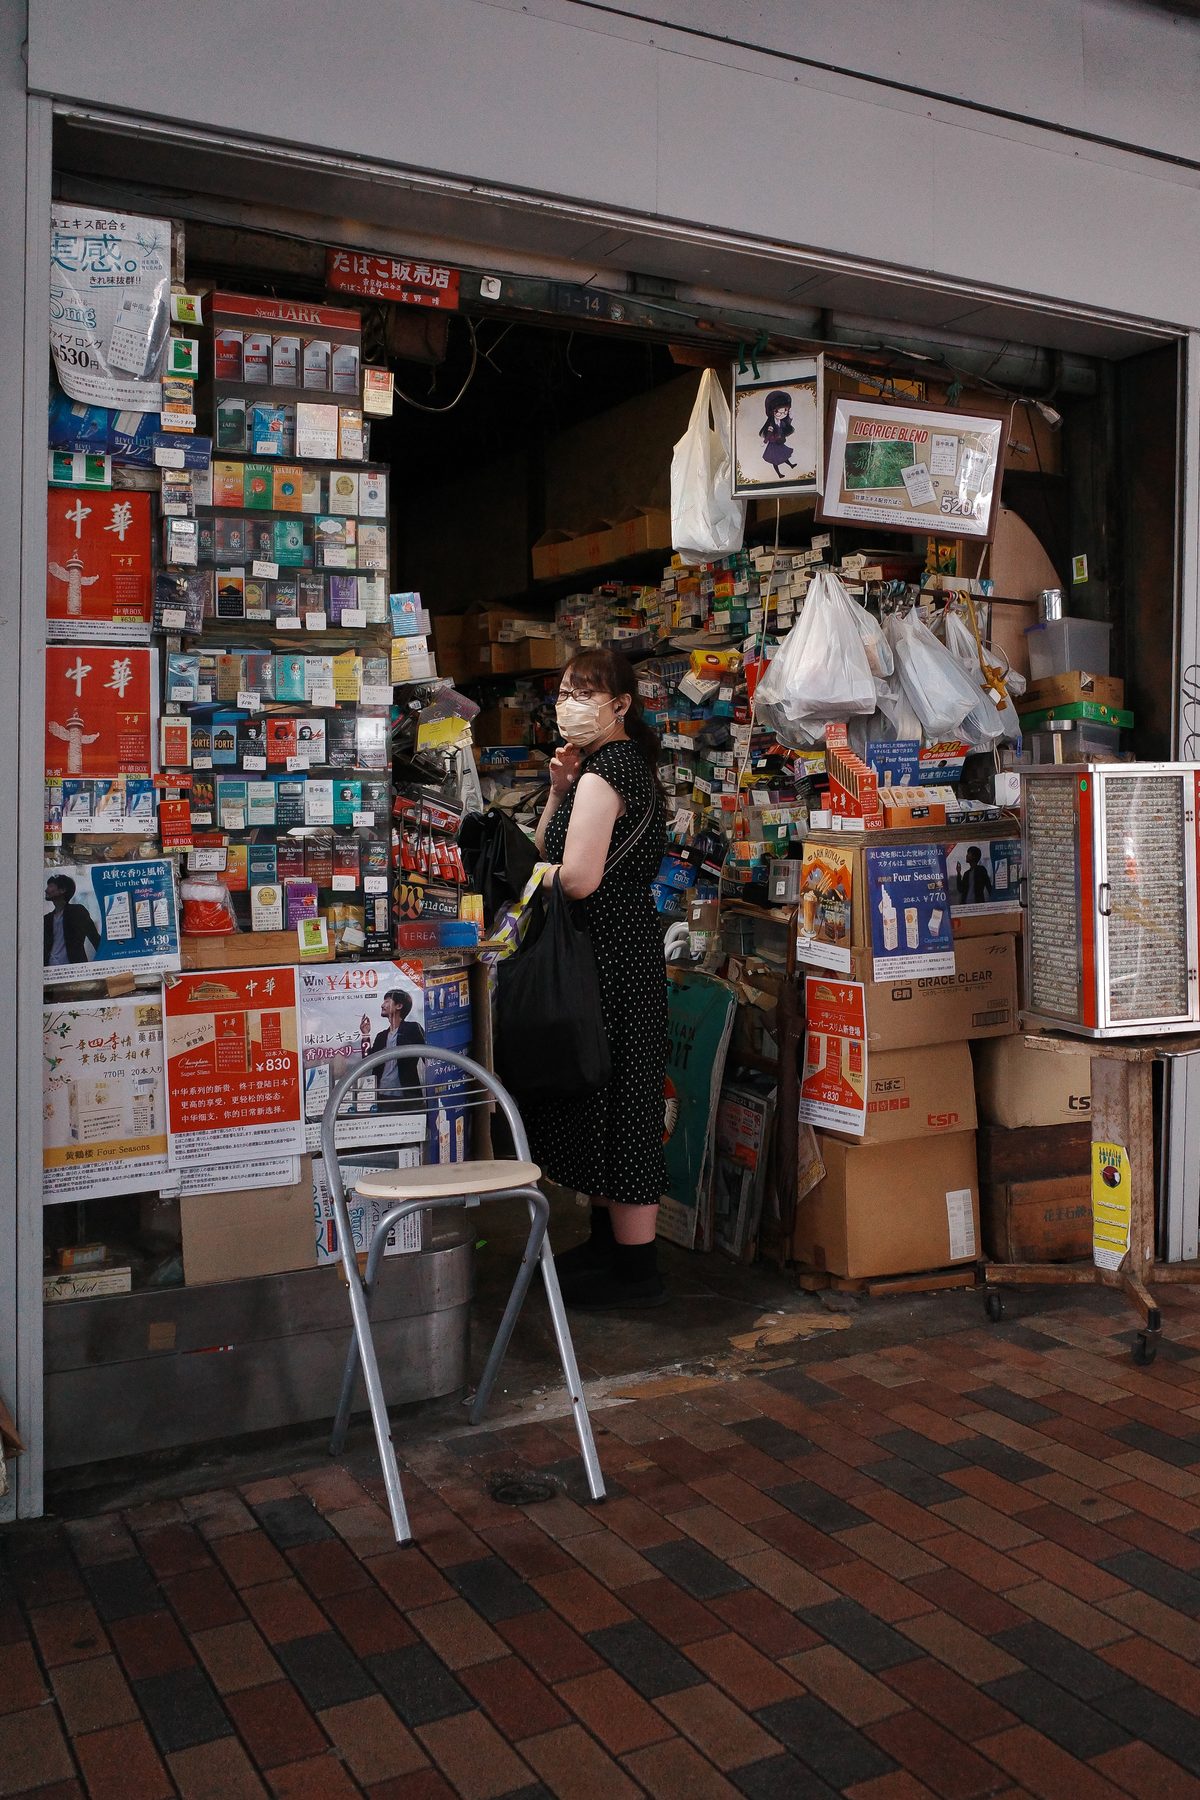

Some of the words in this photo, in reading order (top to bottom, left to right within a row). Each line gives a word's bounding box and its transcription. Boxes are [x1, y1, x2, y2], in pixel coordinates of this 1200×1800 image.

[333, 252, 450, 289] たばこ販売店
[278, 304, 321, 324] LARK
[852, 420, 897, 441] LICORICE
[898, 427, 929, 445] BLEND
[65, 498, 134, 543] 中華
[65, 656, 135, 699] 中華
[214, 739, 234, 749] FORTE
[164, 837, 192, 846] 中華BOX
[825, 849, 841, 865] ROYAL
[102, 866, 166, 880] 良質な香りと風格
[892, 872, 911, 882] Four
[913, 871, 944, 881] Seasons
[923, 892, 947, 903] ¥770
[420, 899, 438, 911] Wild
[438, 902, 458, 913] Card
[144, 934, 170, 946] ¥430
[404, 931, 437, 940] TEREA
[326, 969, 379, 991] ¥430
[917, 975, 955, 988] GRACE
[957, 970, 993, 983] CLEAR
[246, 977, 276, 998] 中華
[171, 1023, 214, 1046] スーパースリム
[808, 1019, 861, 1037] スーパースリム新登場
[186, 1036, 205, 1048] 新登場
[103, 1070, 125, 1079] 770円
[131, 1065, 163, 1076] 20本入り
[256, 1057, 291, 1073] ¥830
[875, 1080, 901, 1092] たばこ
[822, 1090, 840, 1102] ¥830
[1068, 1095, 1091, 1110] ts
[927, 1113, 959, 1126] tsn
[97, 1148, 116, 1156] Four
[118, 1144, 151, 1154] Seasons
